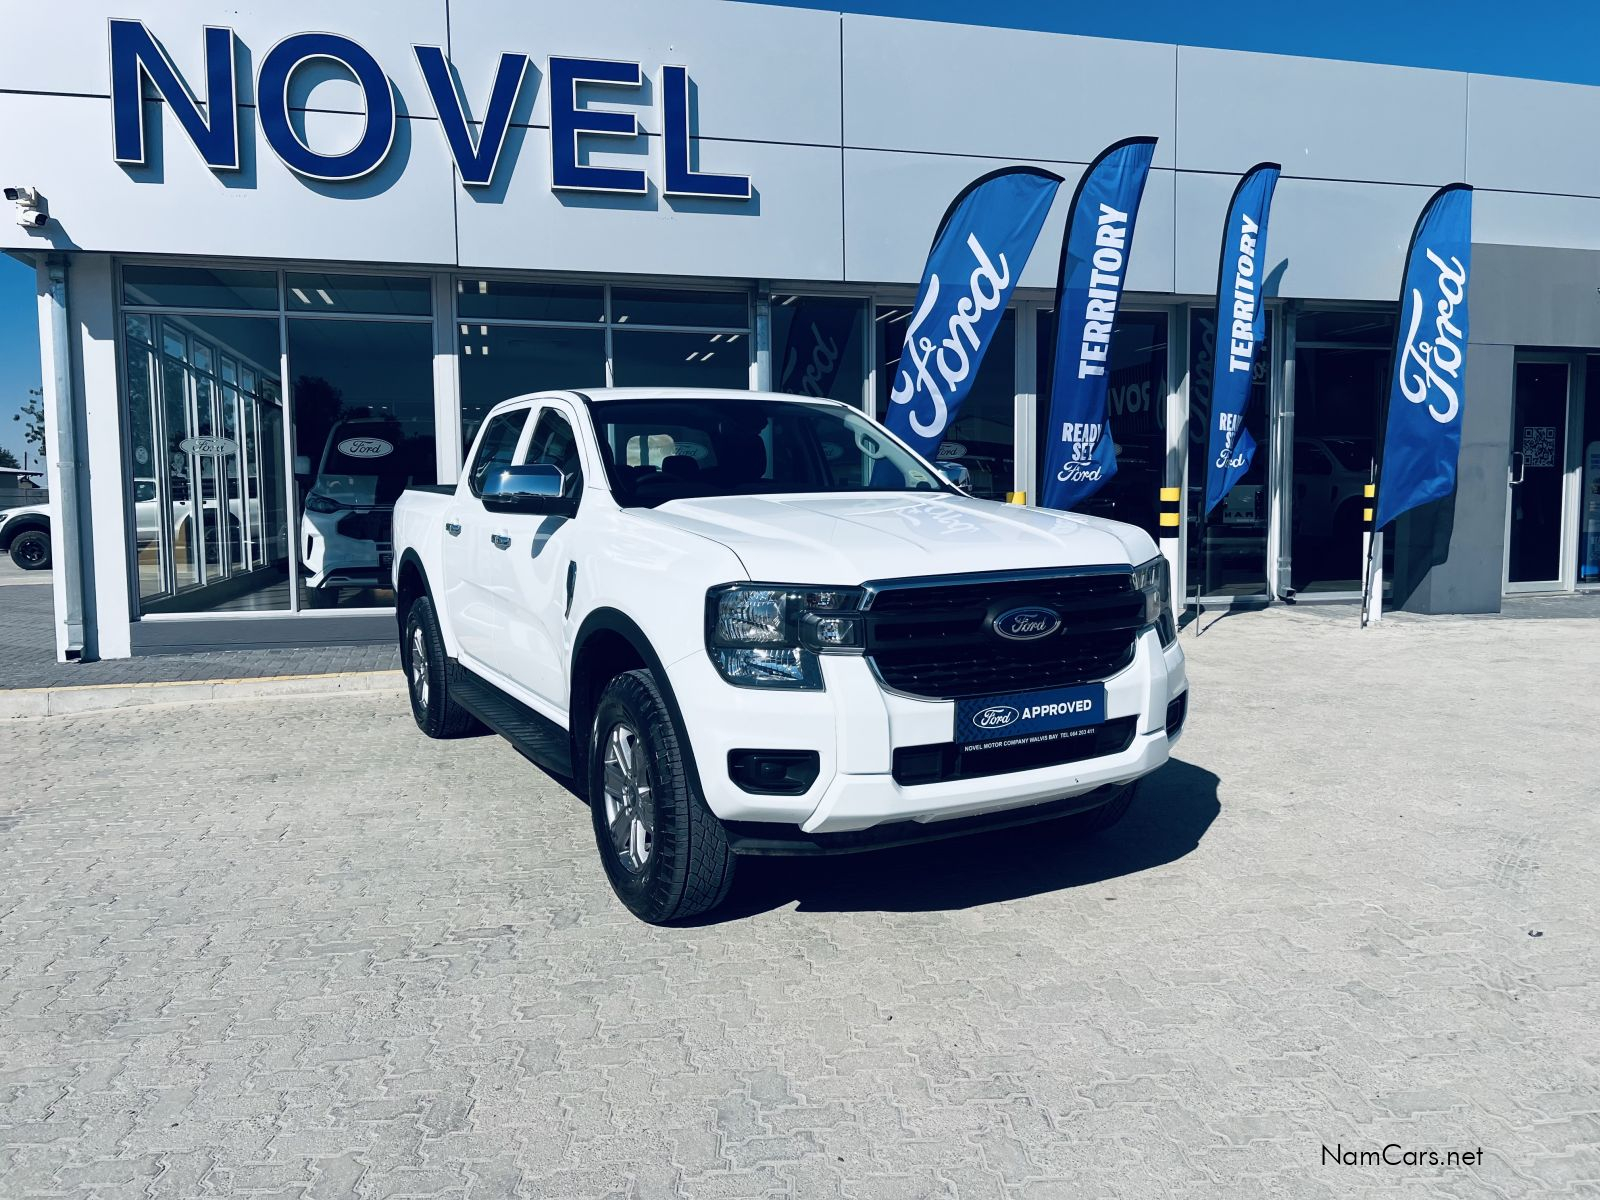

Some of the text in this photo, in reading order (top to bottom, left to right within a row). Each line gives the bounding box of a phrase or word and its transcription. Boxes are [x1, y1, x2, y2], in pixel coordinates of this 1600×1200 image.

[107, 17, 752, 201] NOVEL
[890, 232, 1010, 438] Ford
[1077, 203, 1128, 379] TERRITORY
[1229, 213, 1260, 373] TERRITORY
[1399, 247, 1466, 424] Ford
[349, 440, 382, 454] Ford
[1057, 461, 1102, 482] Ford
[1011, 614, 1047, 633] Ford
[964, 744, 983, 752] NOVEL
[983, 741, 1003, 749] MOTOR
[1003, 738, 1029, 747] COMPANY
[1029, 735, 1048, 743] WALVIS
[980, 699, 1092, 726] Ford APPROVED
